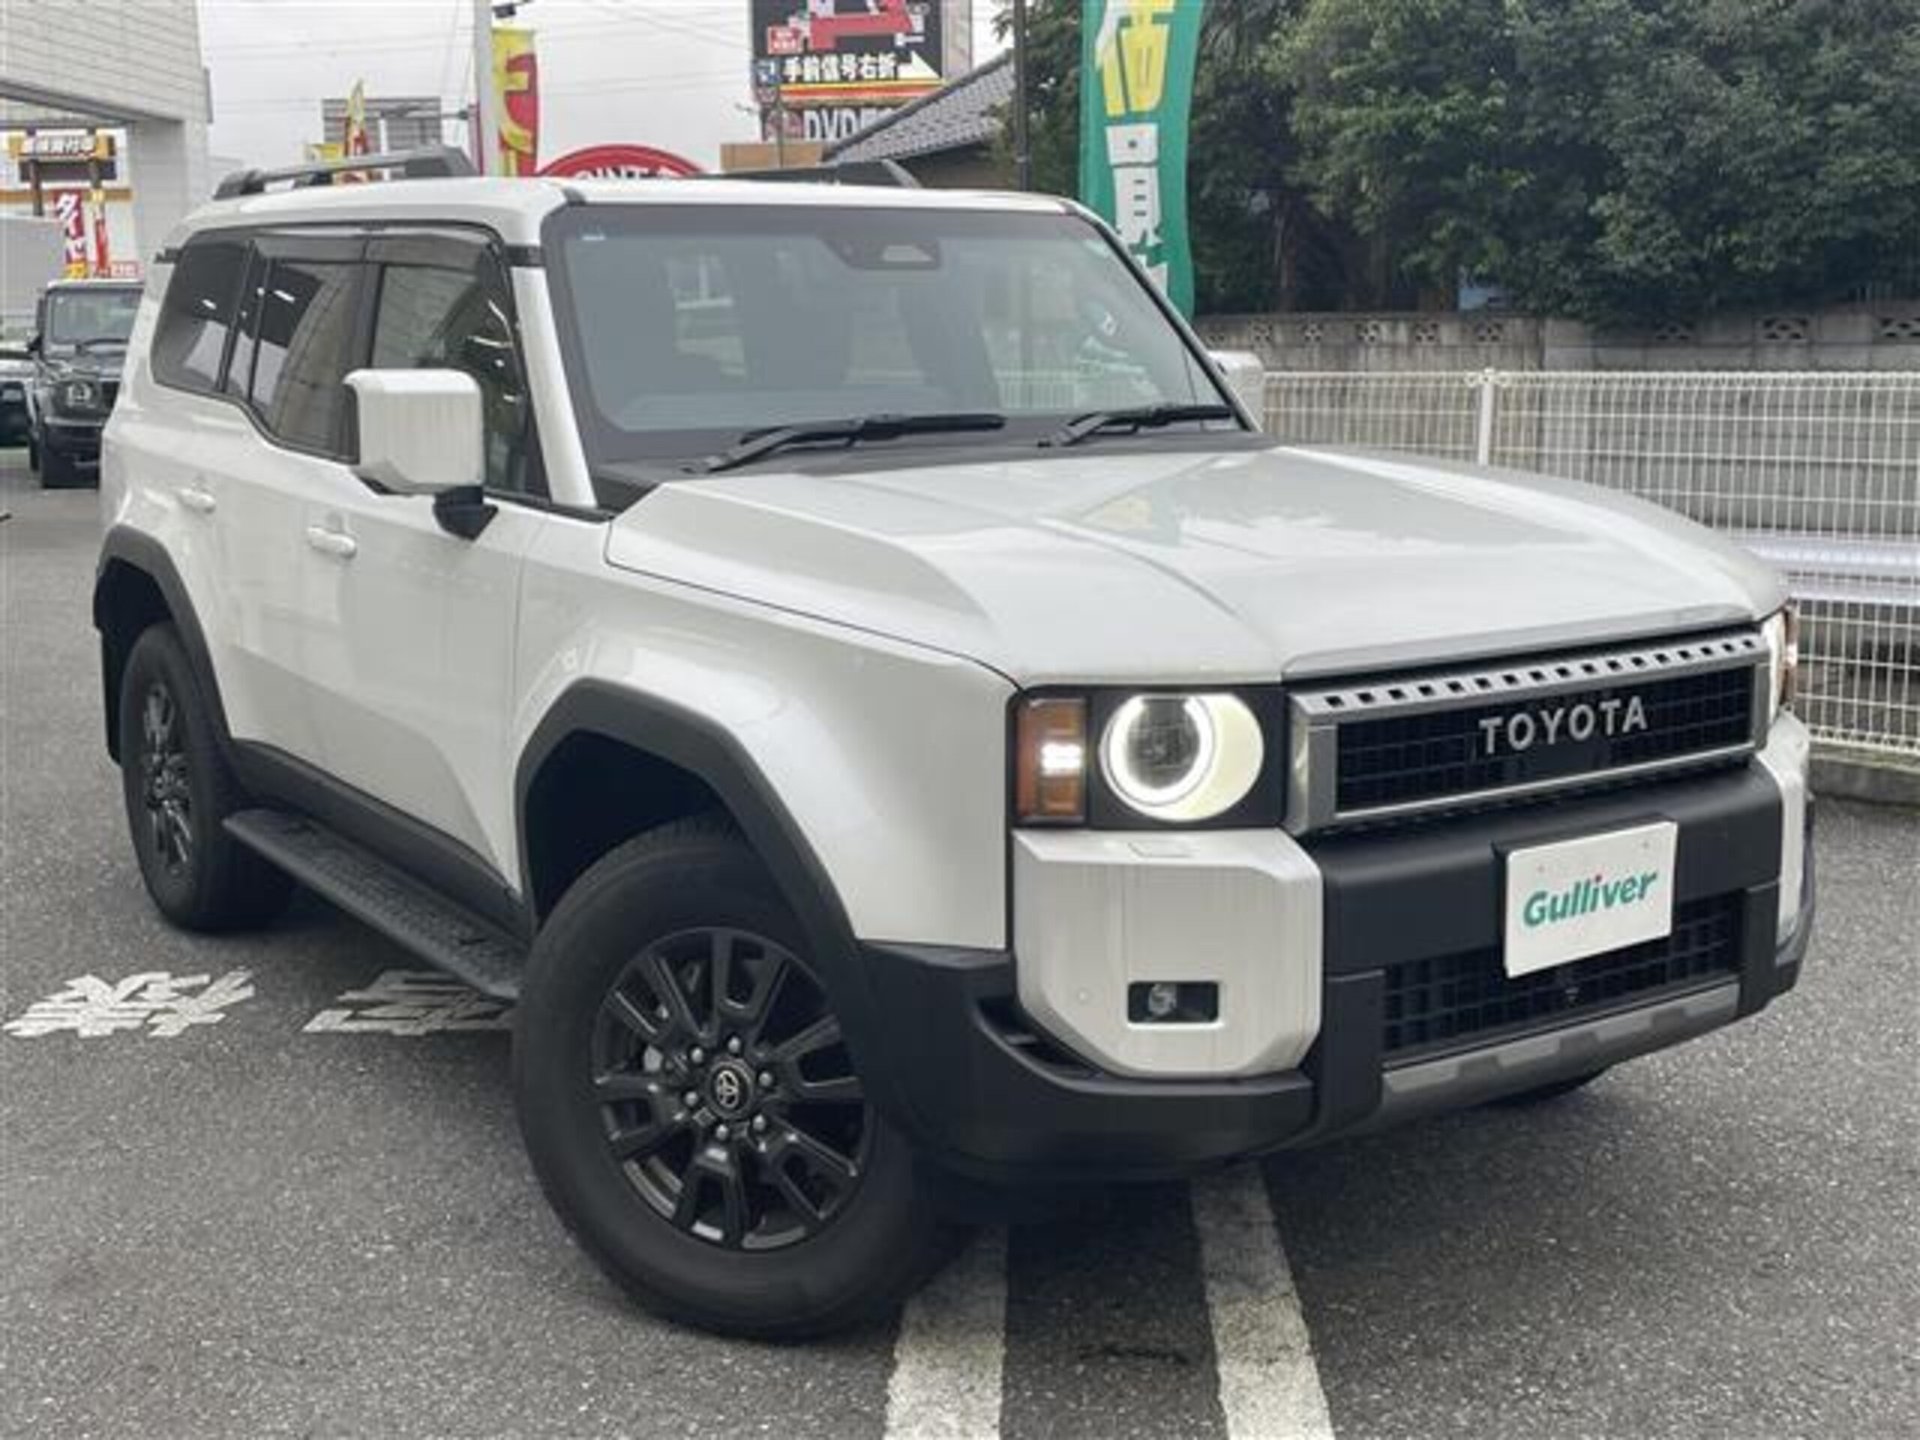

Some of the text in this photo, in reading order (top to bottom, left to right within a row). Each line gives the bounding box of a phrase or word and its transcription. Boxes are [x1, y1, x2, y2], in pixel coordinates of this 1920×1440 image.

[783, 53, 897, 82] 手前信号右折
[1479, 696, 1648, 754] TOYOTA
[1523, 869, 1658, 928] Gulliver
